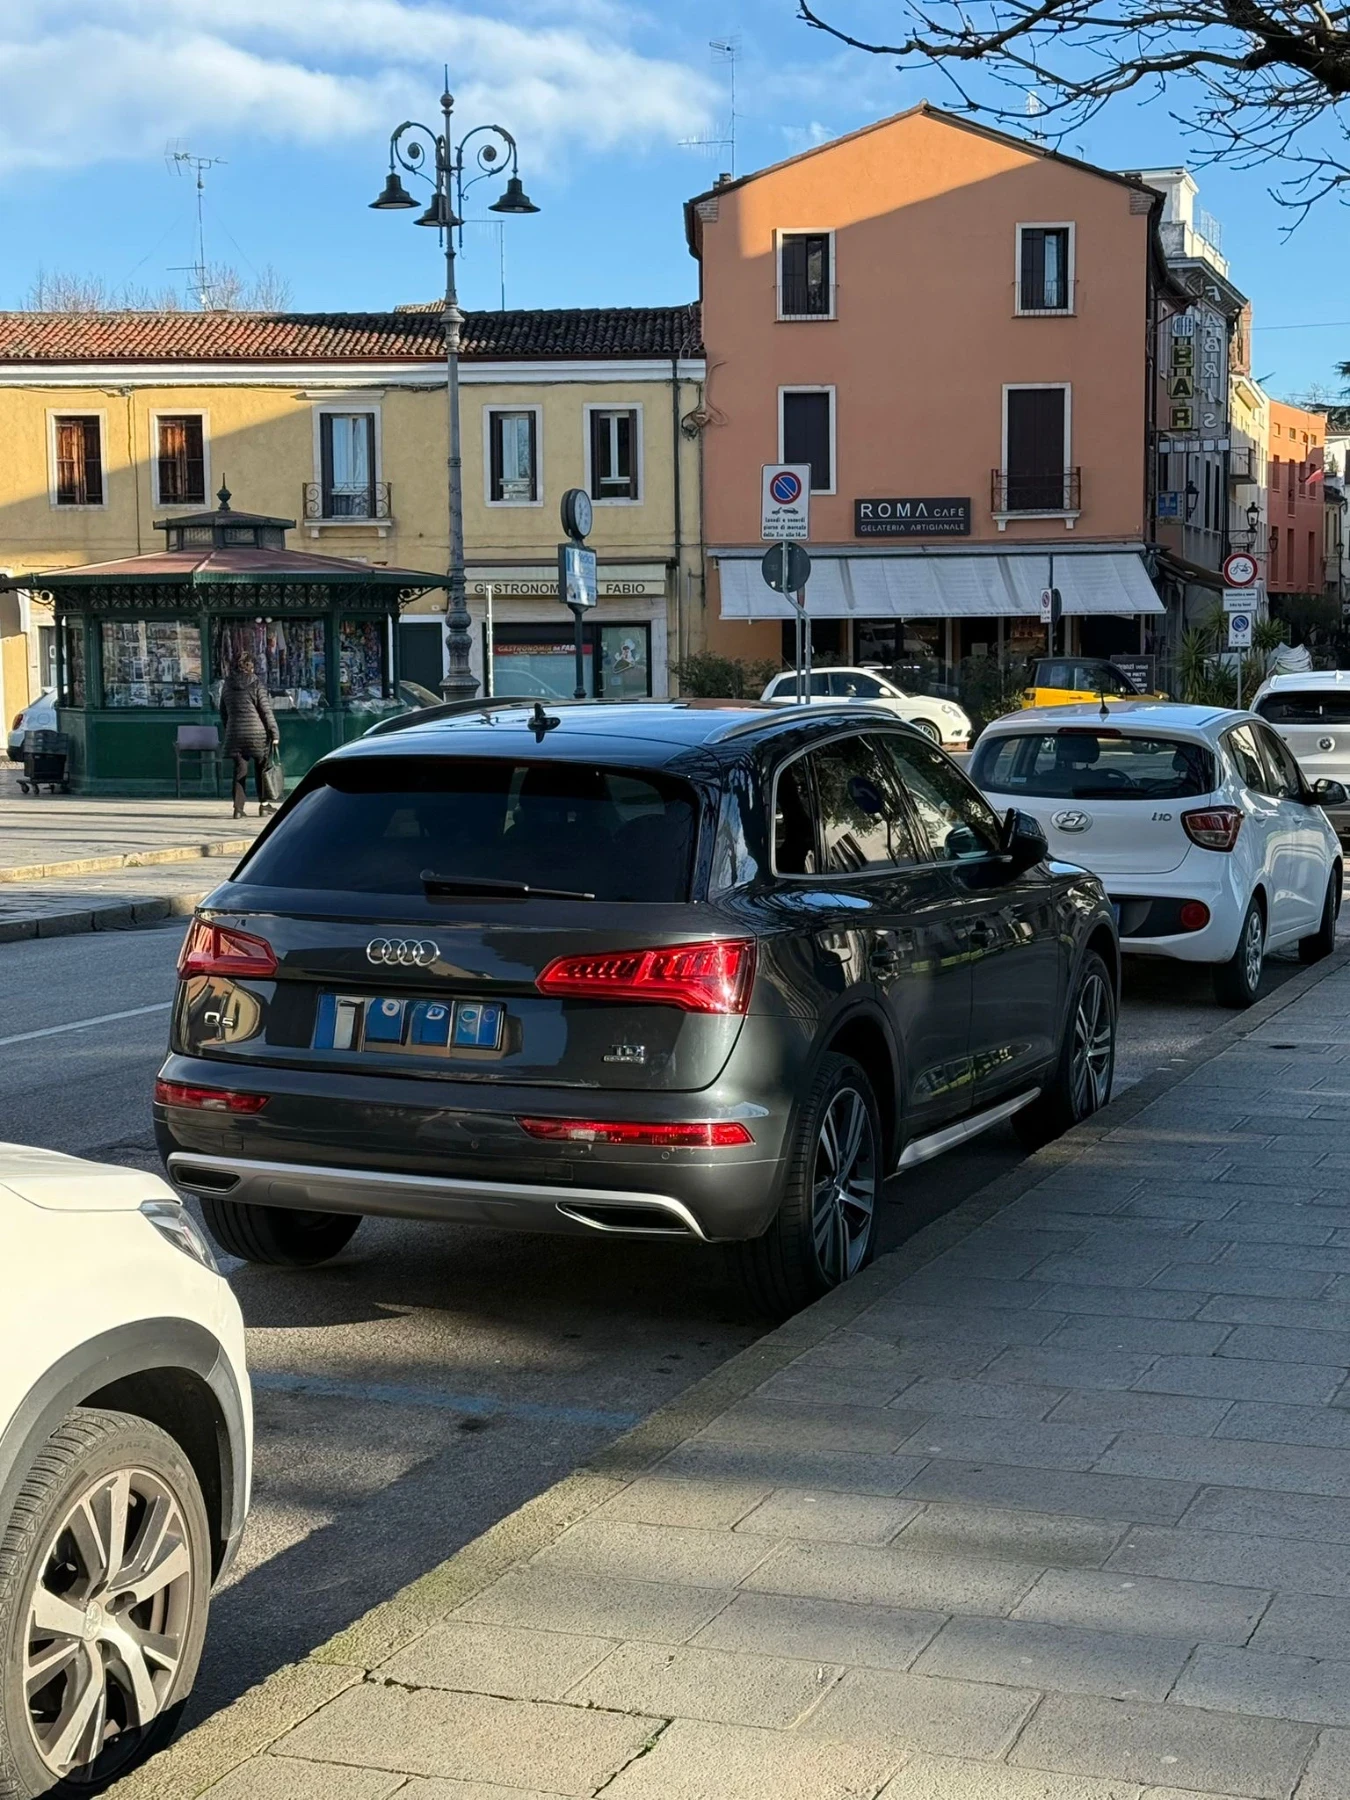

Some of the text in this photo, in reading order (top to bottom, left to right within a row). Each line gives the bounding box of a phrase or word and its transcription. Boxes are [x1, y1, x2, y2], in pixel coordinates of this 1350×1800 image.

[1171, 346, 1192, 429] BAR
[861, 503, 965, 517] ROMA CAFÉ
[861, 523, 965, 532] GELATERIA ARTIGIANALE
[474, 583, 560, 594] GSTRONOM
[606, 583, 645, 594] FABIO
[1151, 812, 1173, 822] i10
[204, 1011, 234, 1029] Q5
